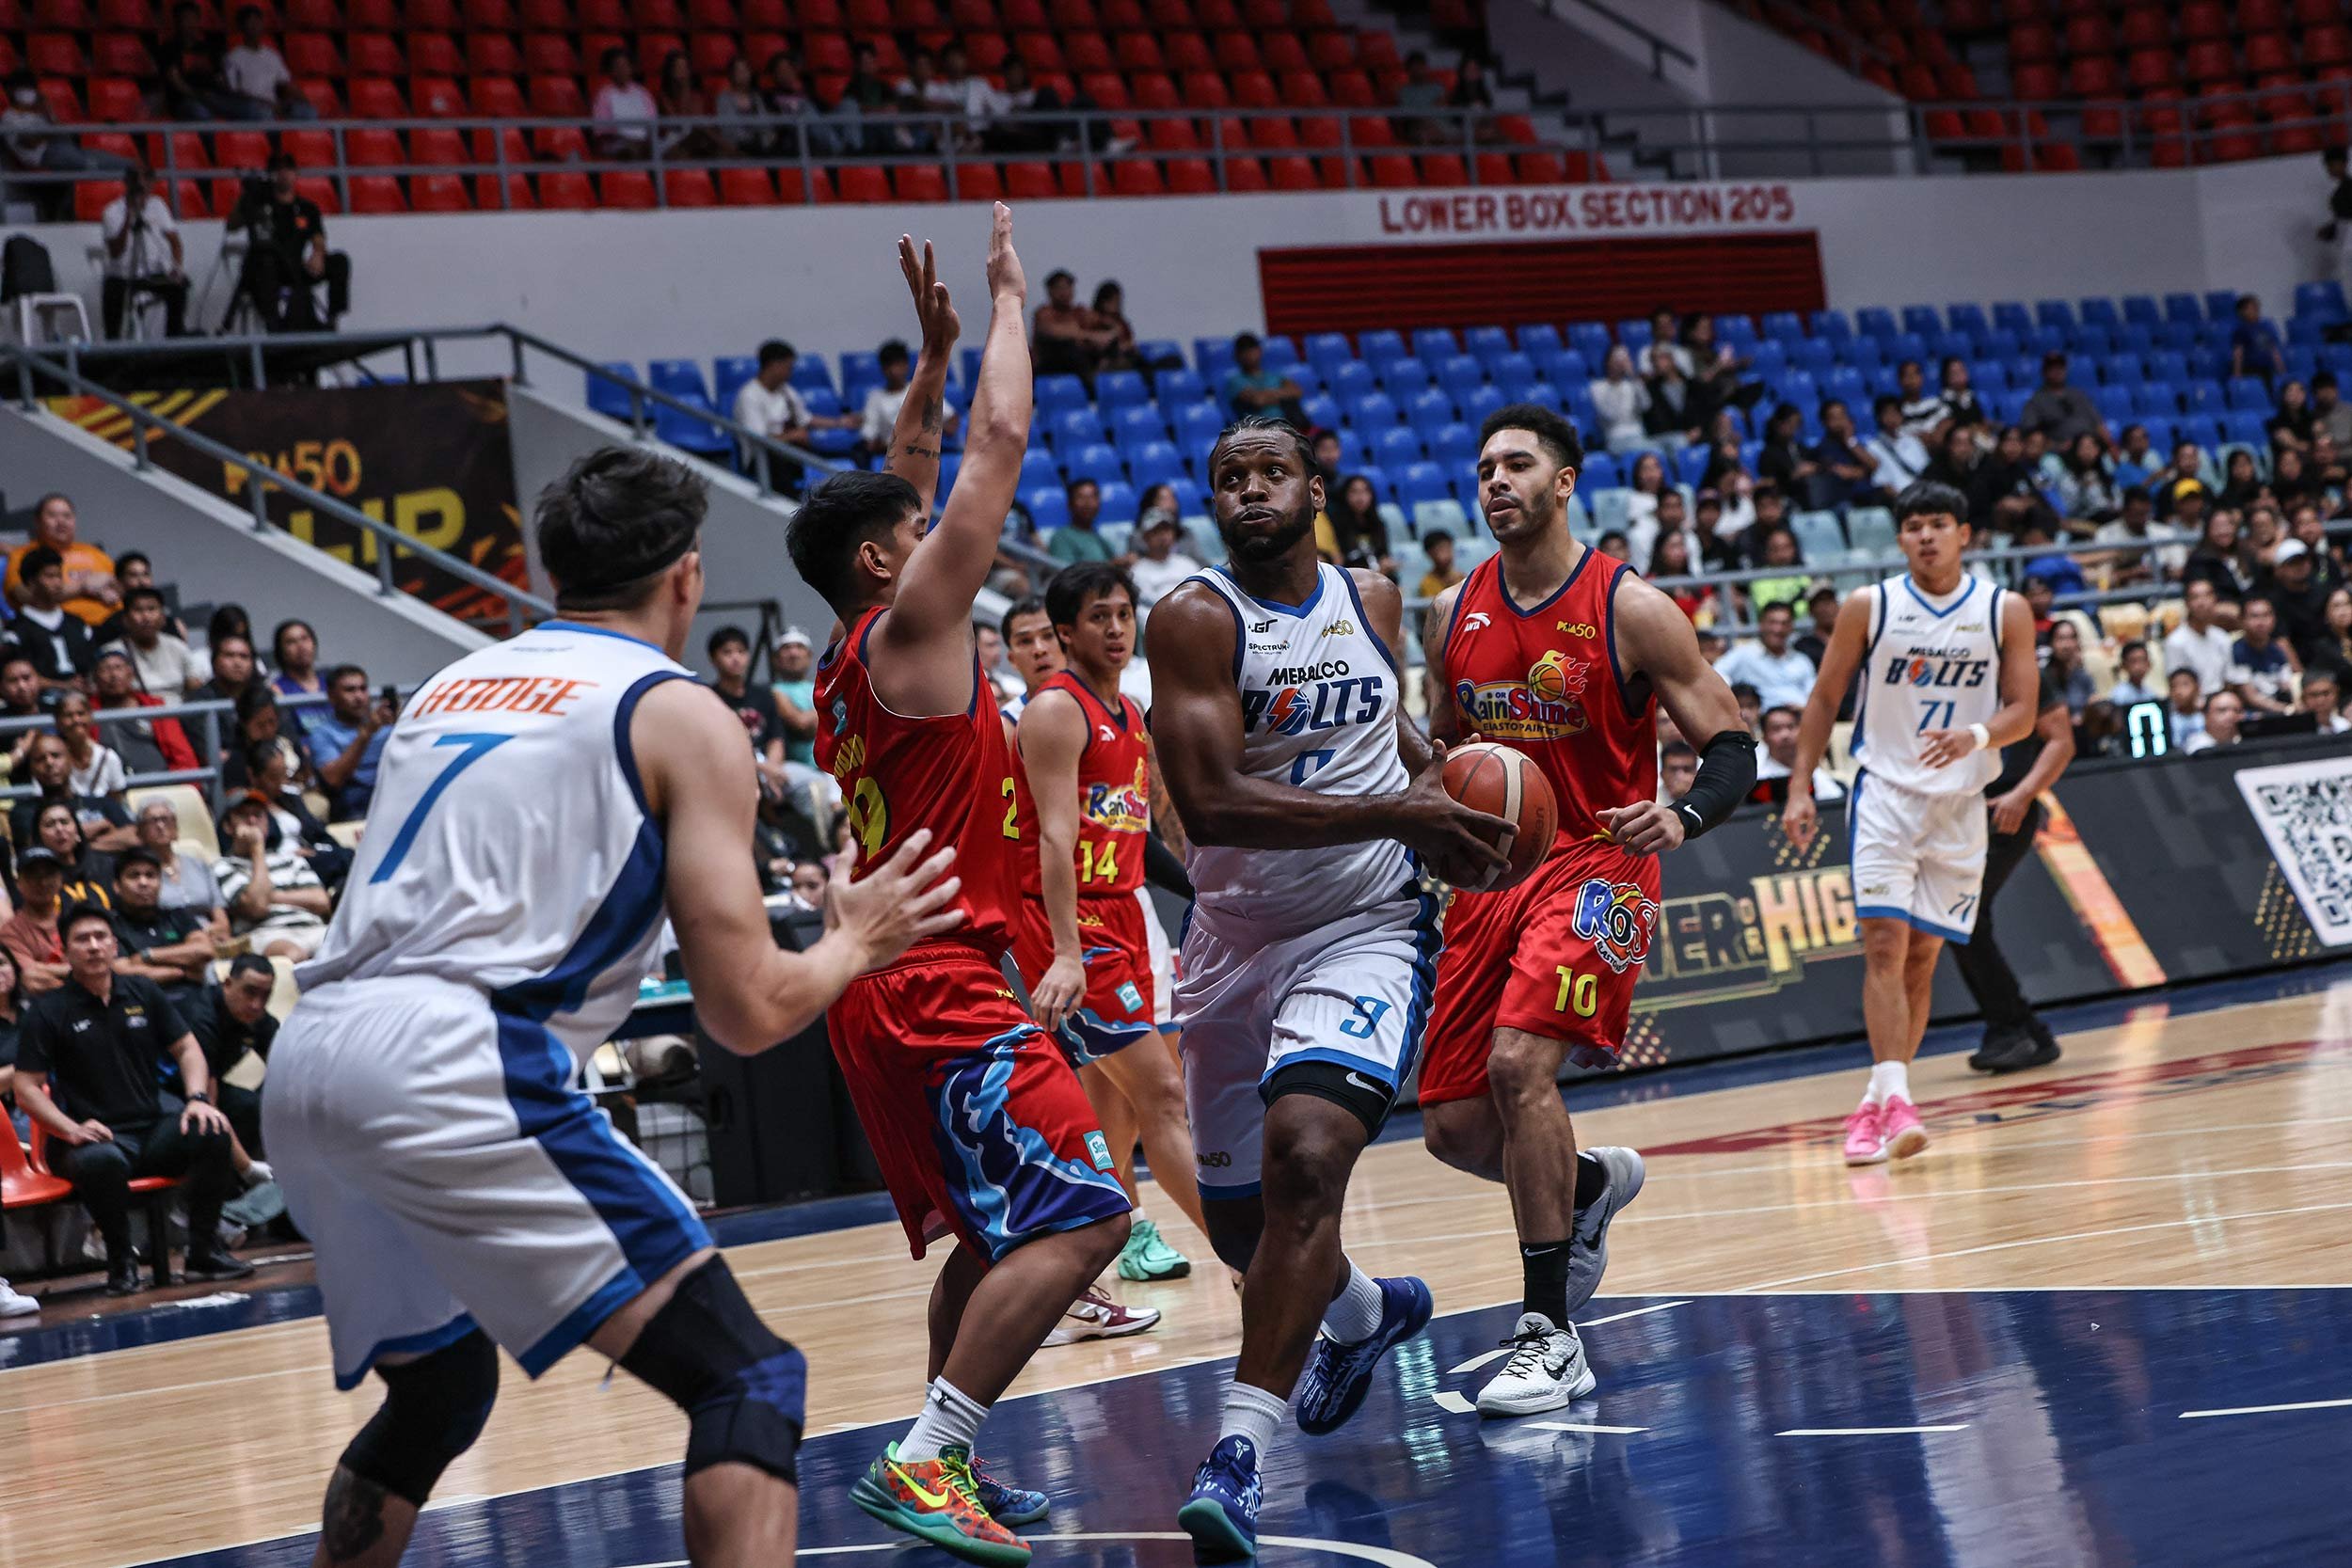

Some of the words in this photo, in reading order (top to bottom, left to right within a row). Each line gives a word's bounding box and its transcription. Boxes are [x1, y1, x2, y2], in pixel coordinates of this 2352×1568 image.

[1379, 195, 1498, 233] LOWER
[1506, 193, 1573, 232] BOX
[1581, 188, 1722, 228] SECTION
[1728, 185, 1795, 223] 205
[1266, 659, 1350, 687] MERALCO
[1884, 657, 1990, 688] BOLTS
[412, 676, 600, 720] HODGE
[1915, 700, 1957, 738] 71
[369, 732, 517, 886] 7
[1079, 840, 1120, 885] 14
[1948, 892, 1977, 923] 71
[1554, 965, 1598, 1018] 10
